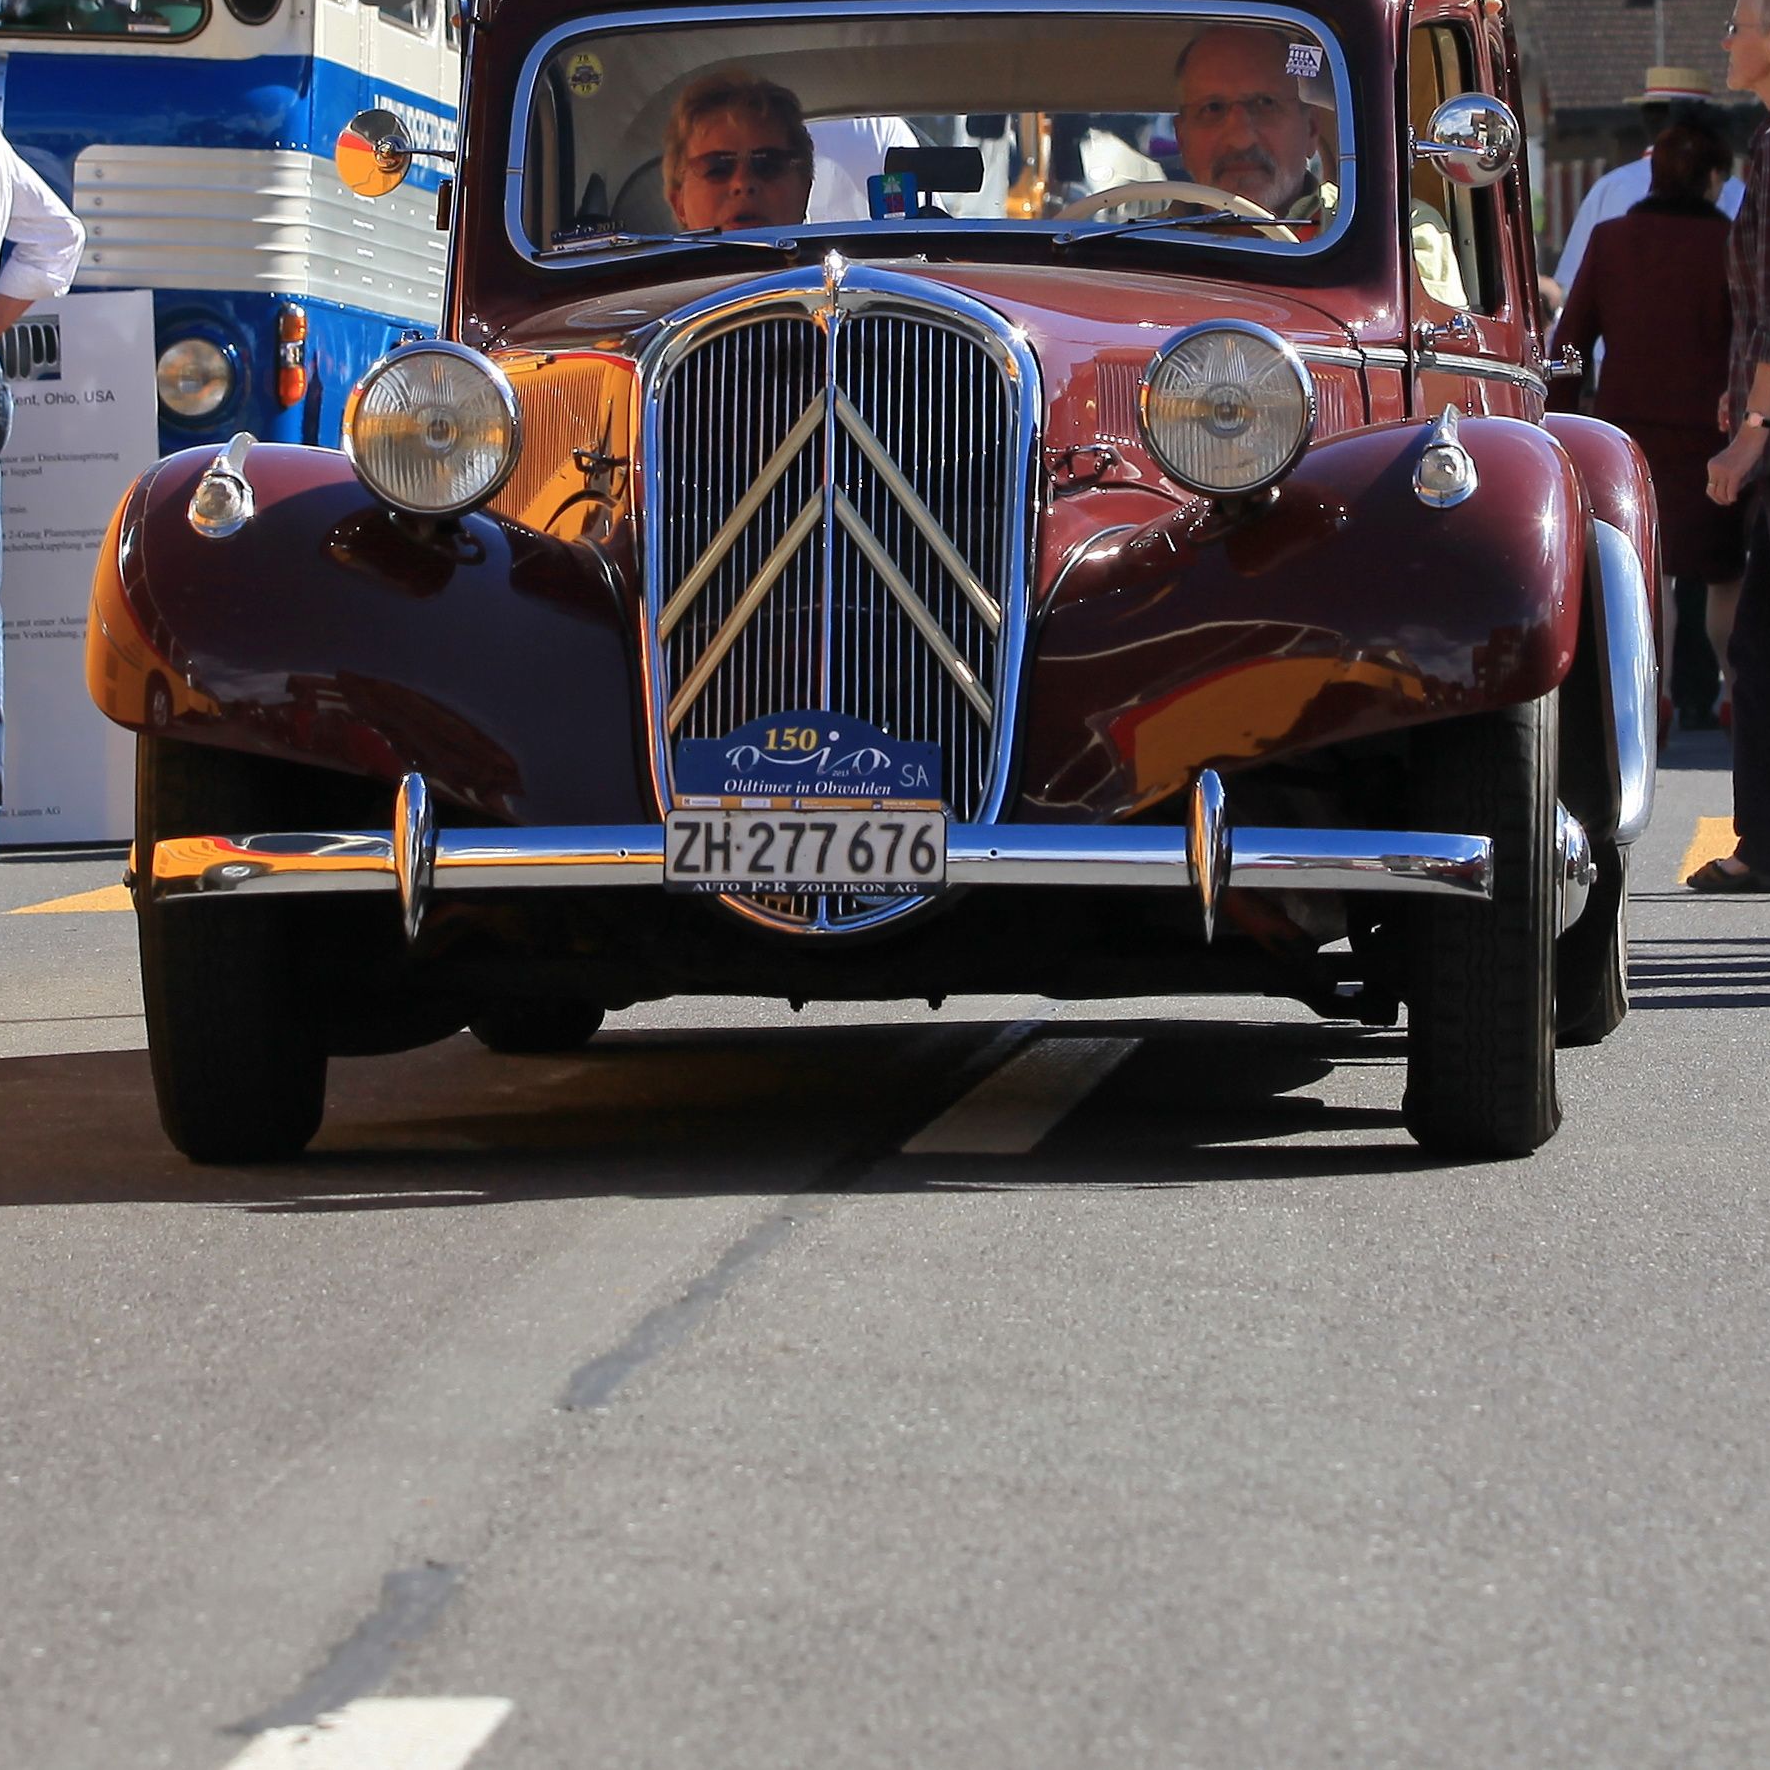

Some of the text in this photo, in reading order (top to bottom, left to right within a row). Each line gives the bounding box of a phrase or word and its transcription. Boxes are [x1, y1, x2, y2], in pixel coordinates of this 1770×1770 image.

[44, 392, 80, 406] Ohio,
[84, 389, 116, 403] USA
[764, 728, 818, 752] 150
[899, 763, 930, 788] SA
[724, 779, 892, 796] Oldtimer in Obwalden
[693, 882, 741, 893] AUTO
[796, 882, 887, 893] ZOLLIKON
[892, 882, 918, 893] AG
